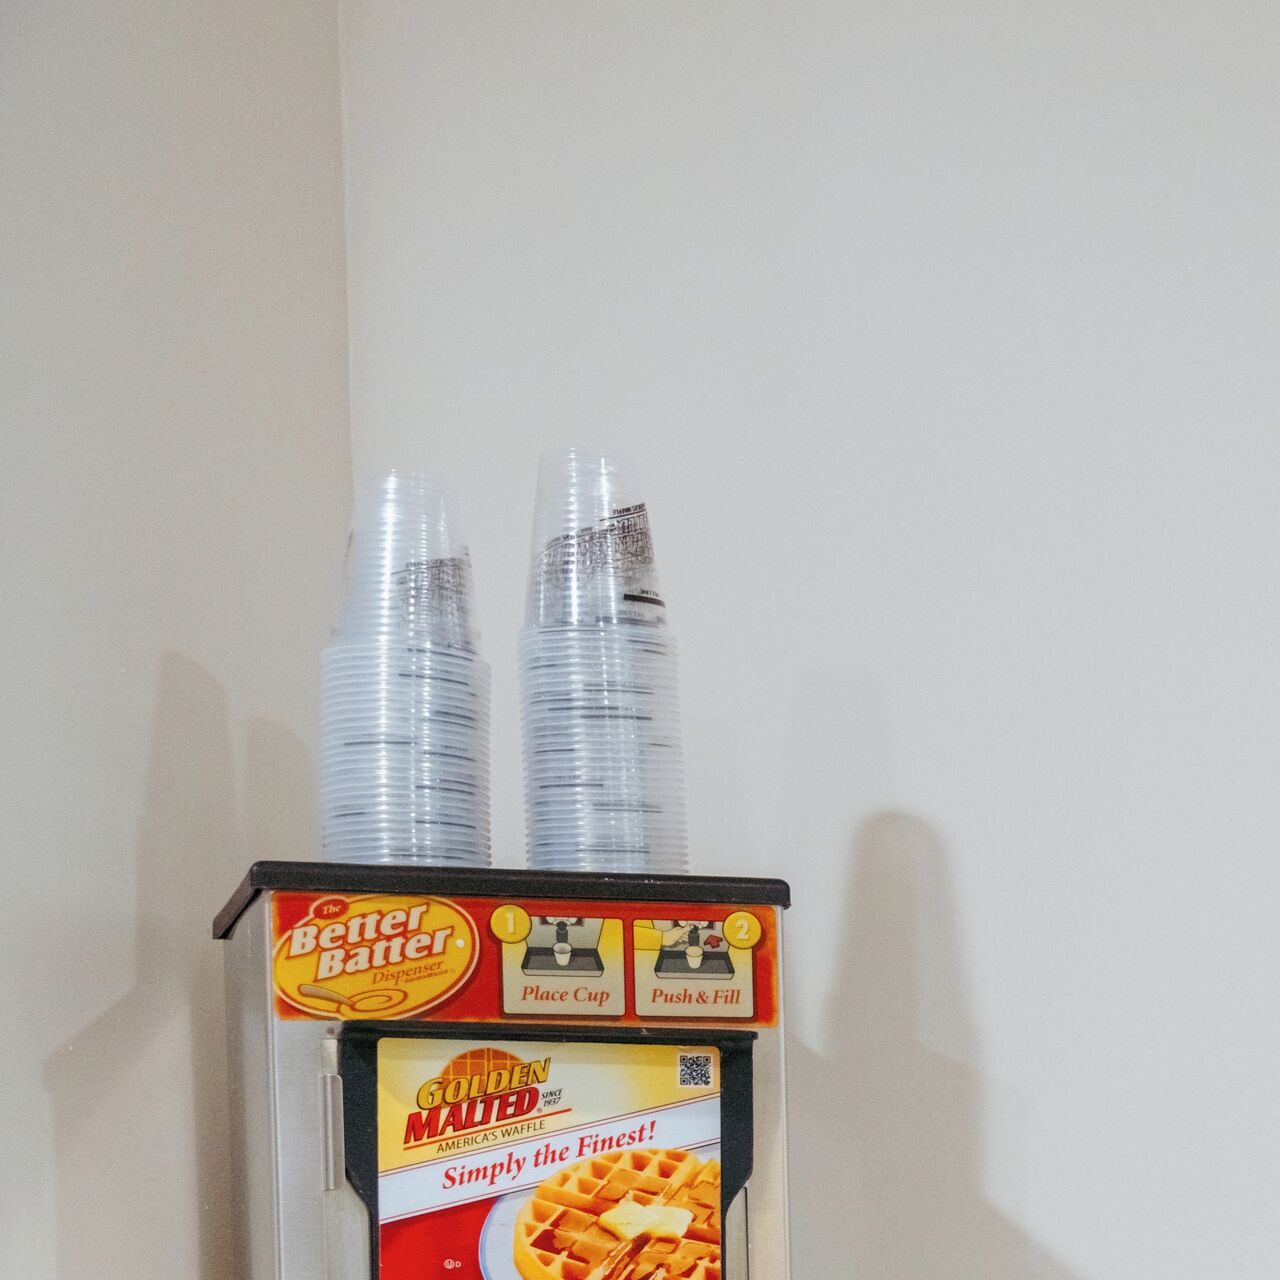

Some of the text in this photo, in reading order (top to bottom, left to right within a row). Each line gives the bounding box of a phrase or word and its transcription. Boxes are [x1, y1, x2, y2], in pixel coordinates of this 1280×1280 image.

[321, 903, 342, 914] The
[287, 903, 428, 958] Better
[505, 911, 516, 934] 1
[735, 919, 750, 940] 2
[315, 927, 453, 981] Batter
[371, 959, 445, 986] Dispenser
[521, 985, 610, 1007] Place Cup
[651, 988, 740, 1005] Push & Fill
[416, 1057, 551, 1110] GOLDEN
[541, 1088, 564, 1100] SINCE
[543, 1096, 562, 1107] 1937
[403, 1086, 540, 1145] MALTED
[436, 1119, 546, 1154] AMERICA'S WAFFLE
[442, 1120, 657, 1190] Simply the Finest!
